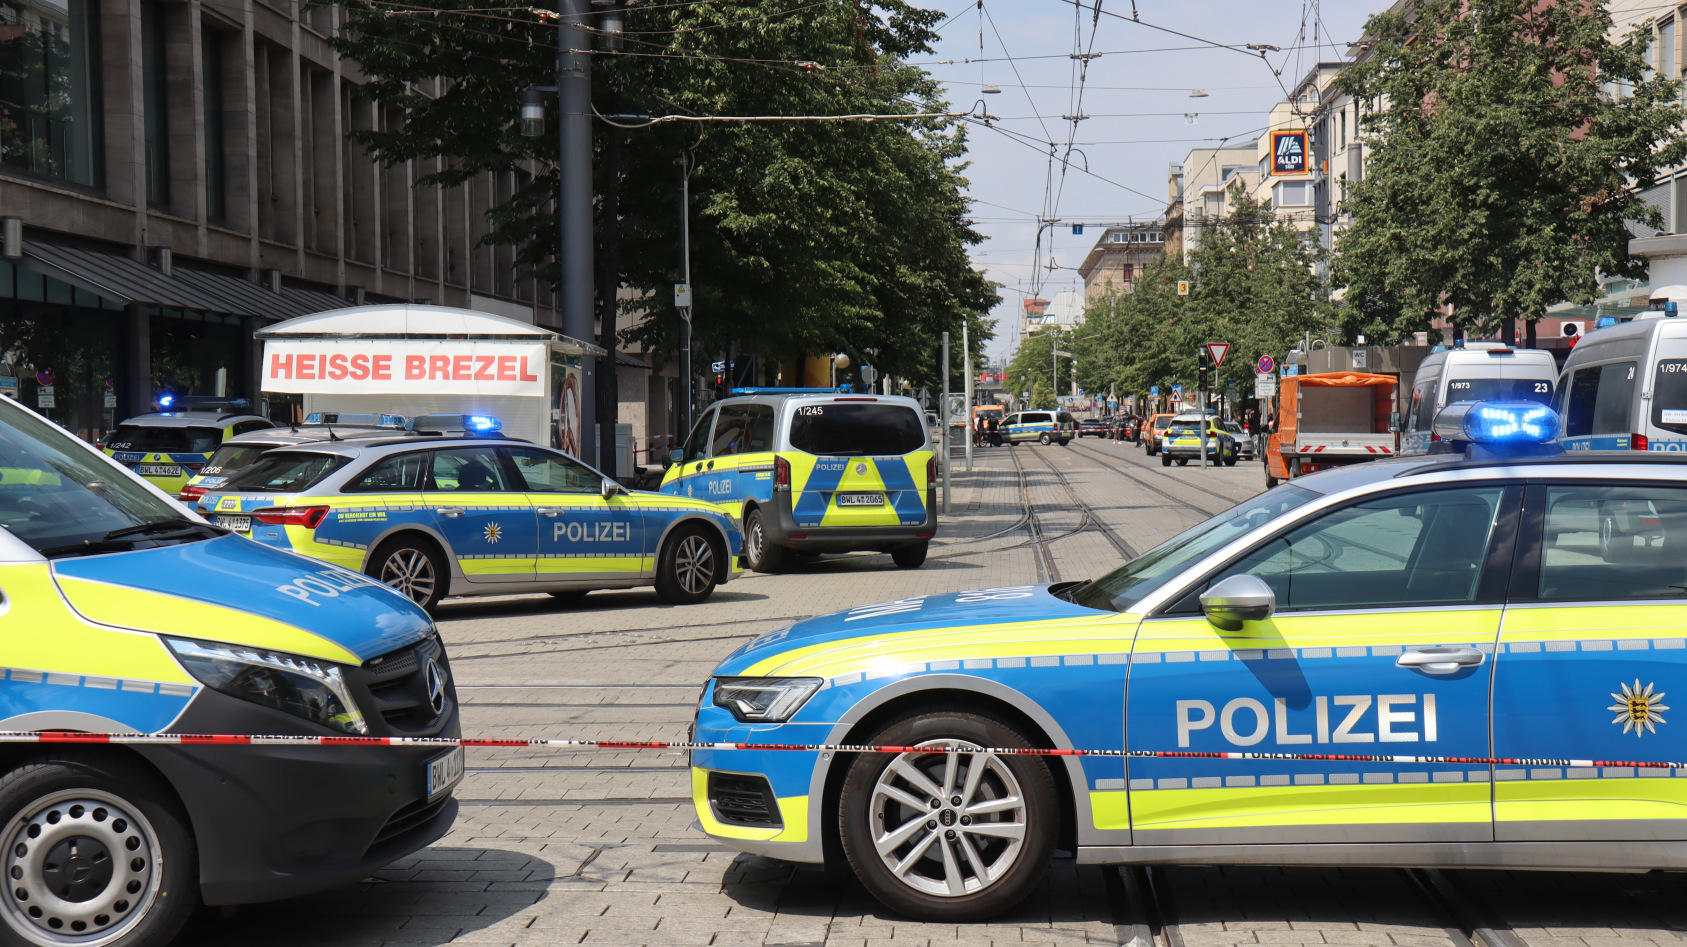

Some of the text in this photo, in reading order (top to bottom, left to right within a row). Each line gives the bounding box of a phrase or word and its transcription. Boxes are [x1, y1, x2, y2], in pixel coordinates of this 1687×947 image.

[1278, 156, 1302, 164] ALDI
[1181, 284, 1187, 292] 3
[270, 354, 538, 382] HEISSE BREZEL
[1659, 364, 1687, 373] 1/974
[1535, 383, 1548, 393] 23
[798, 407, 823, 416] 1/245
[140, 466, 153, 475] BWL
[154, 466, 159, 474] 4
[200, 466, 222, 474] 1/206
[709, 479, 732, 495] POLIZEI
[841, 495, 882, 503] BWL 4 2065
[235, 517, 250, 528] 1375
[553, 522, 630, 542] POLIZEI
[1176, 693, 1437, 748] POLIZEI
